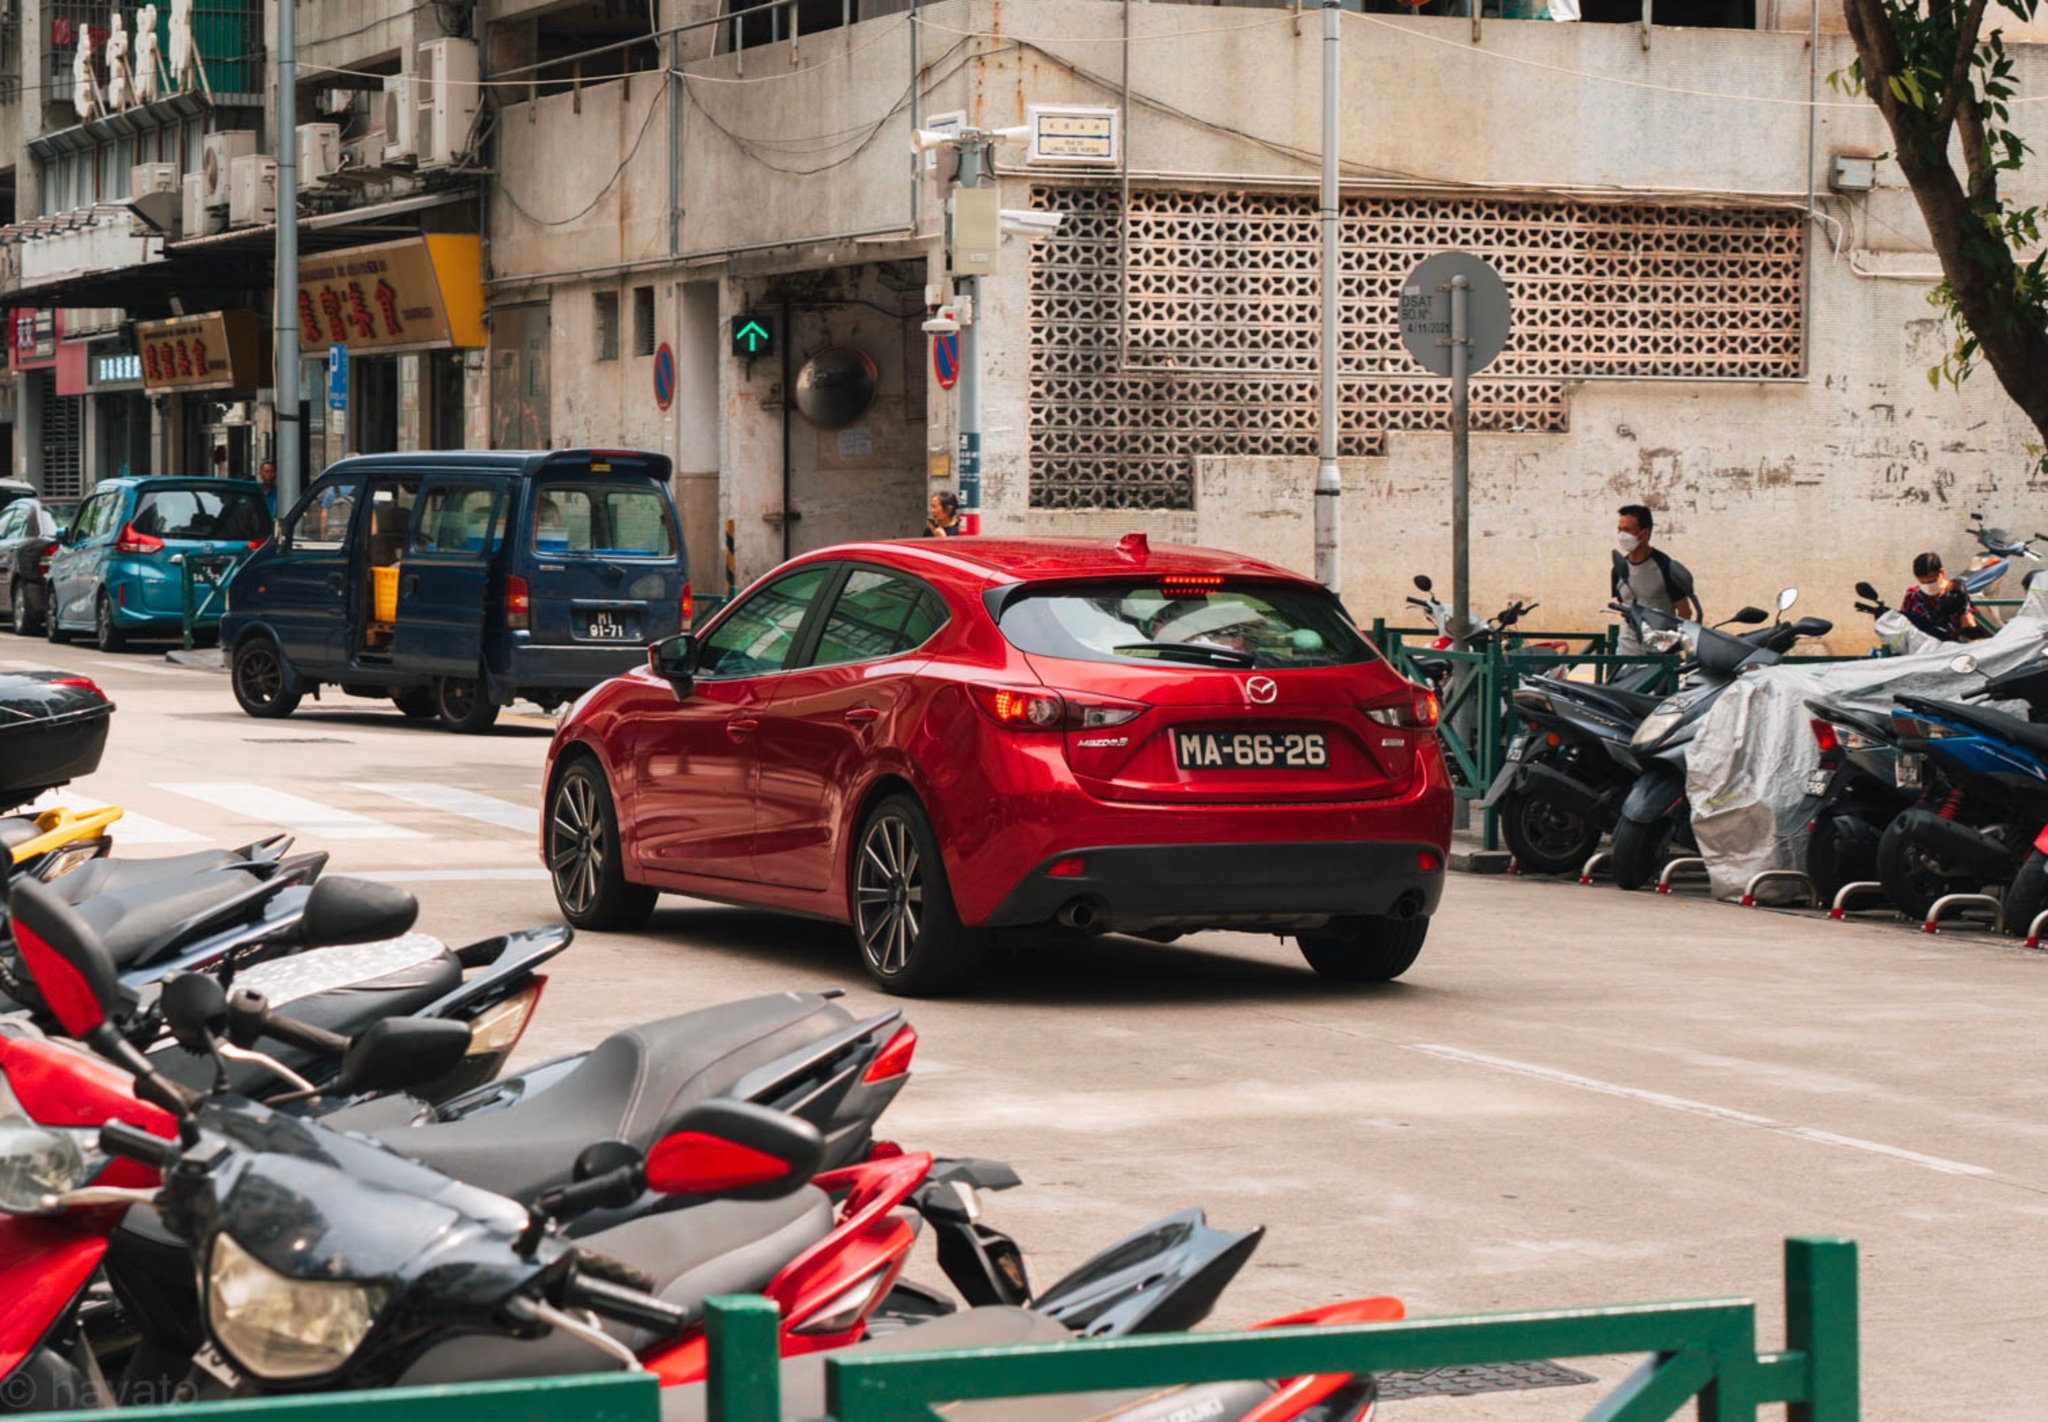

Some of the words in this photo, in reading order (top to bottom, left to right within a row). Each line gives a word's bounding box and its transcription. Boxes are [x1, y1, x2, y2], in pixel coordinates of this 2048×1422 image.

[1401, 295, 1432, 308] DSAT
[589, 624, 624, 638] 91-71
[1179, 734, 1326, 766] MA-66-26
